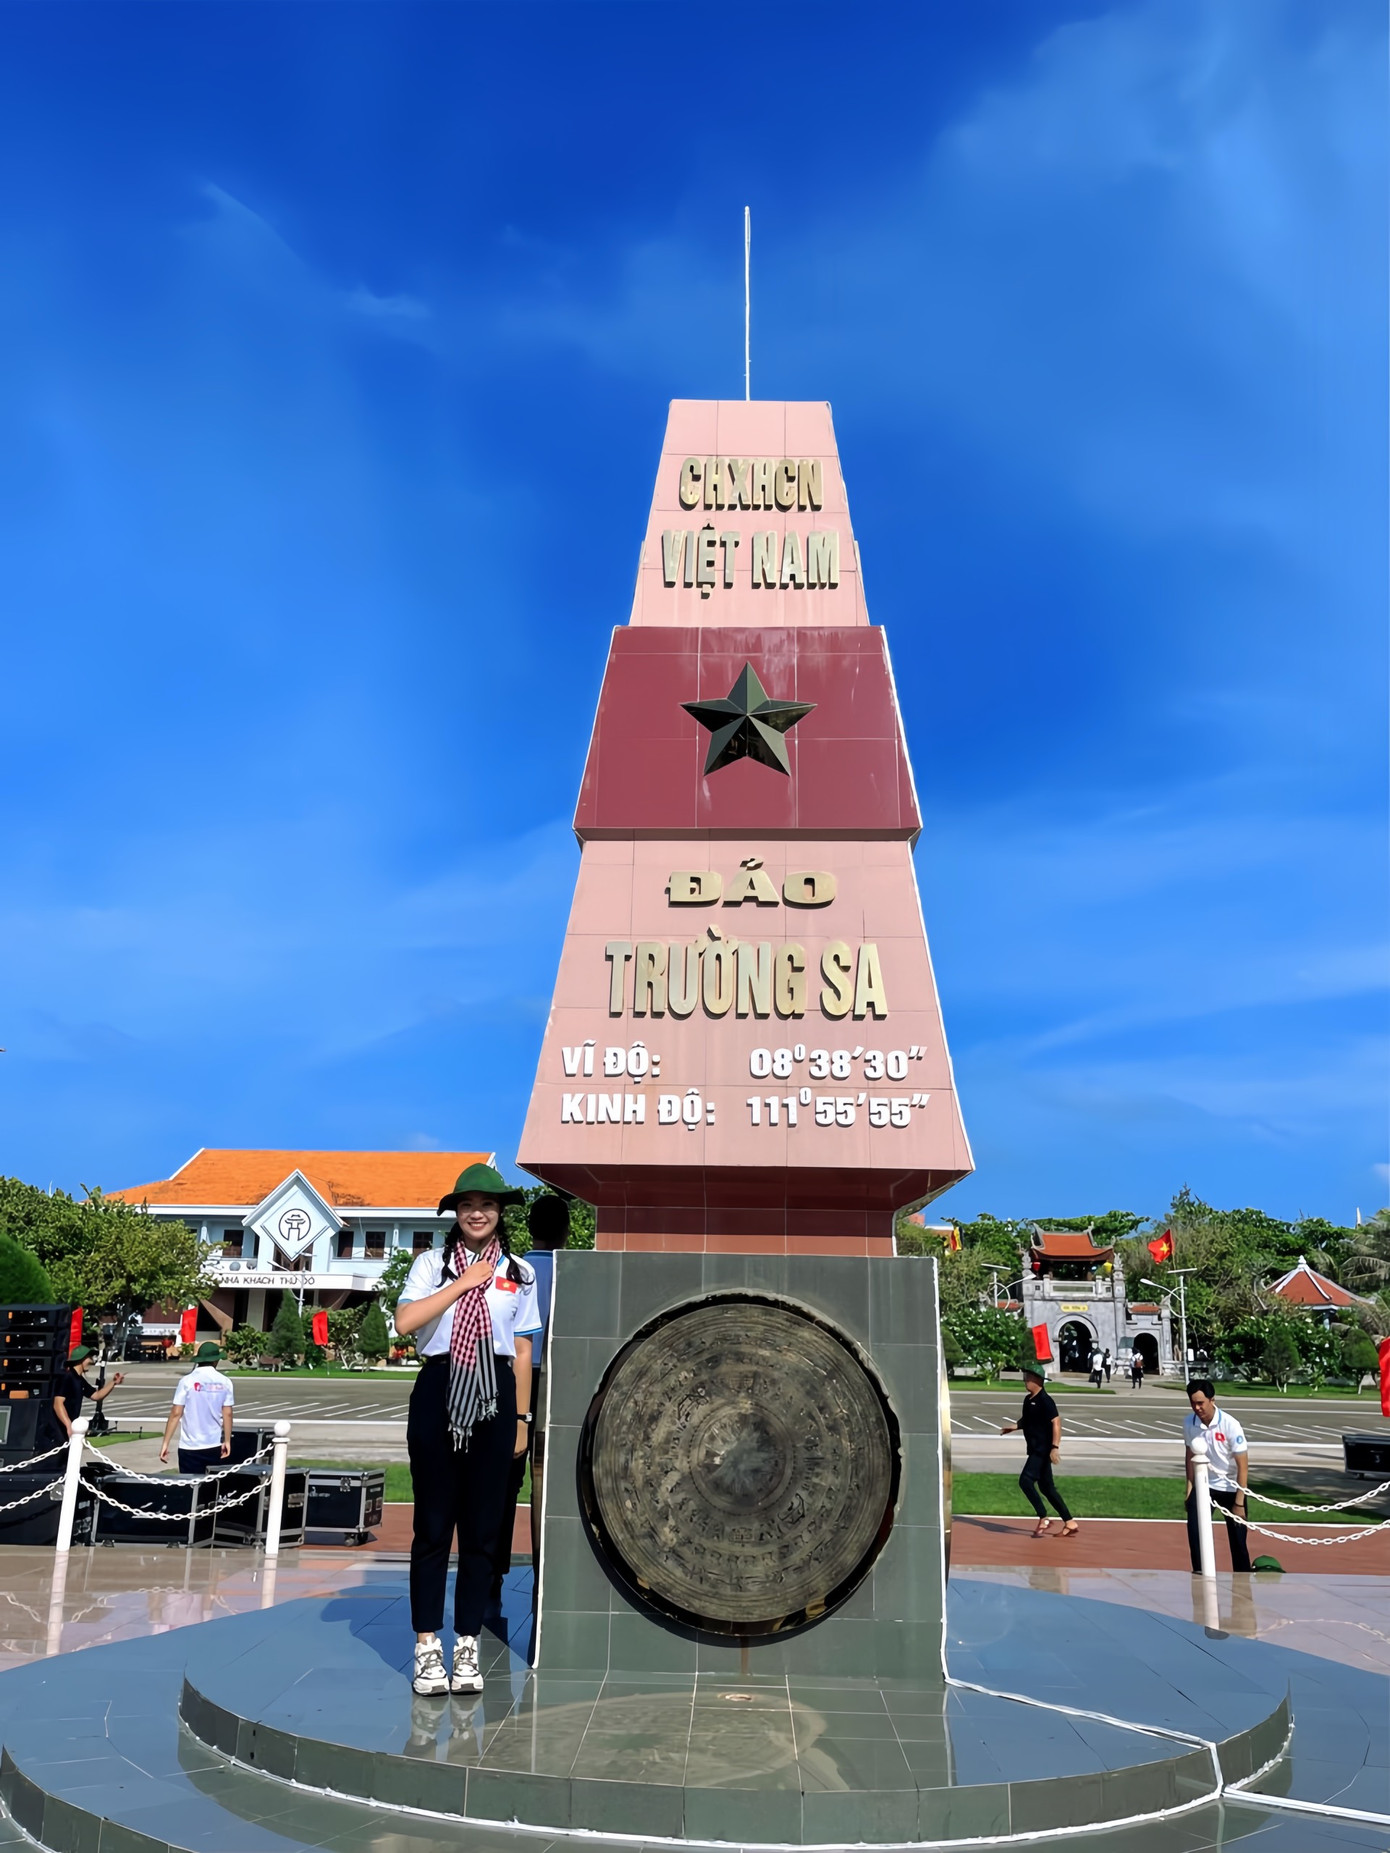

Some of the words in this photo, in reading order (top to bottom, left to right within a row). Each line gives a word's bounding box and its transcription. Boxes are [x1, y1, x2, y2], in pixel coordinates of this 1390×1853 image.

[679, 457, 822, 512] CHXHCN
[661, 519, 740, 599] VIỆT
[751, 531, 840, 590] NAM
[664, 857, 837, 910] ĐẢO
[605, 924, 806, 1020] TRƯỜNG
[819, 940, 888, 1021] SA
[562, 1039, 597, 1077] VĨ
[603, 1041, 661, 1084] ĐỘ:
[561, 1093, 646, 1124] KINH
[657, 1088, 716, 1131] ĐỘ:
